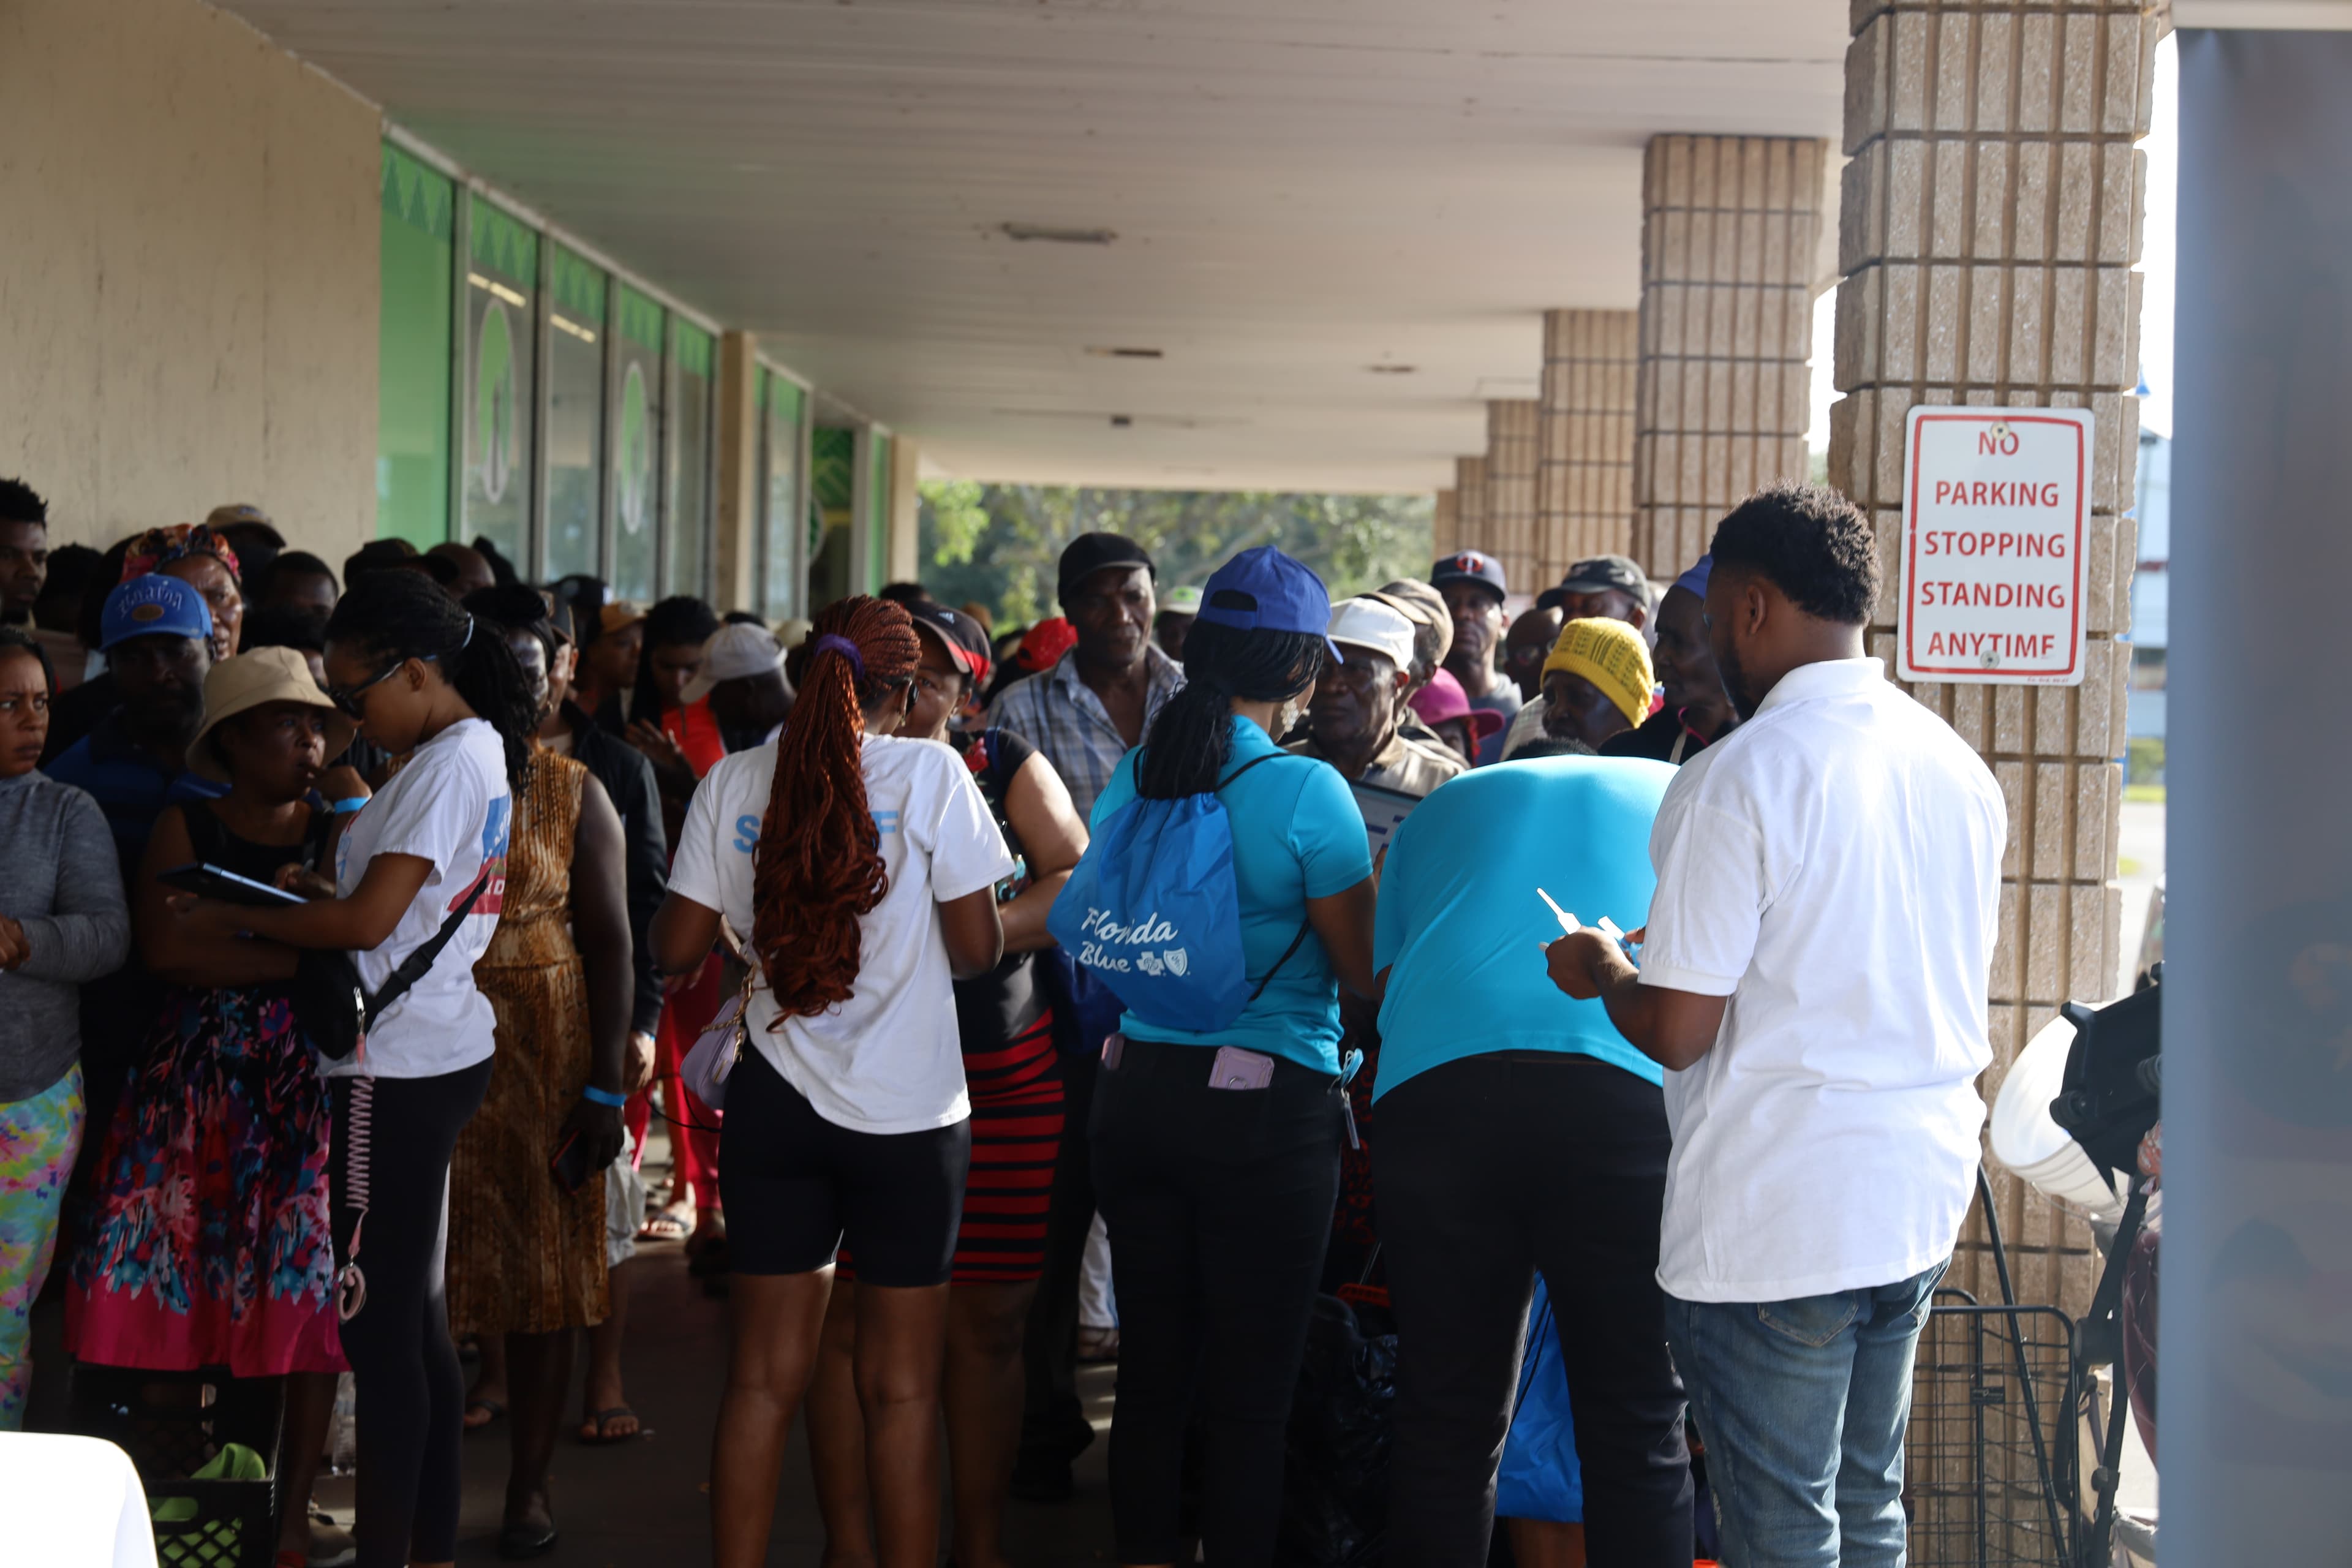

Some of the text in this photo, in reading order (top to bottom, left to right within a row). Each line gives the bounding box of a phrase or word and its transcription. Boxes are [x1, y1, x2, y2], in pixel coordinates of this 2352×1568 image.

[1978, 431, 2019, 456] NO
[1935, 480, 2059, 507] PARKING
[1924, 530, 2065, 558] STOPPING
[1921, 581, 2065, 608] STANDING
[1927, 631, 2056, 658] ANYTIME
[1078, 941, 1131, 973] Blue
